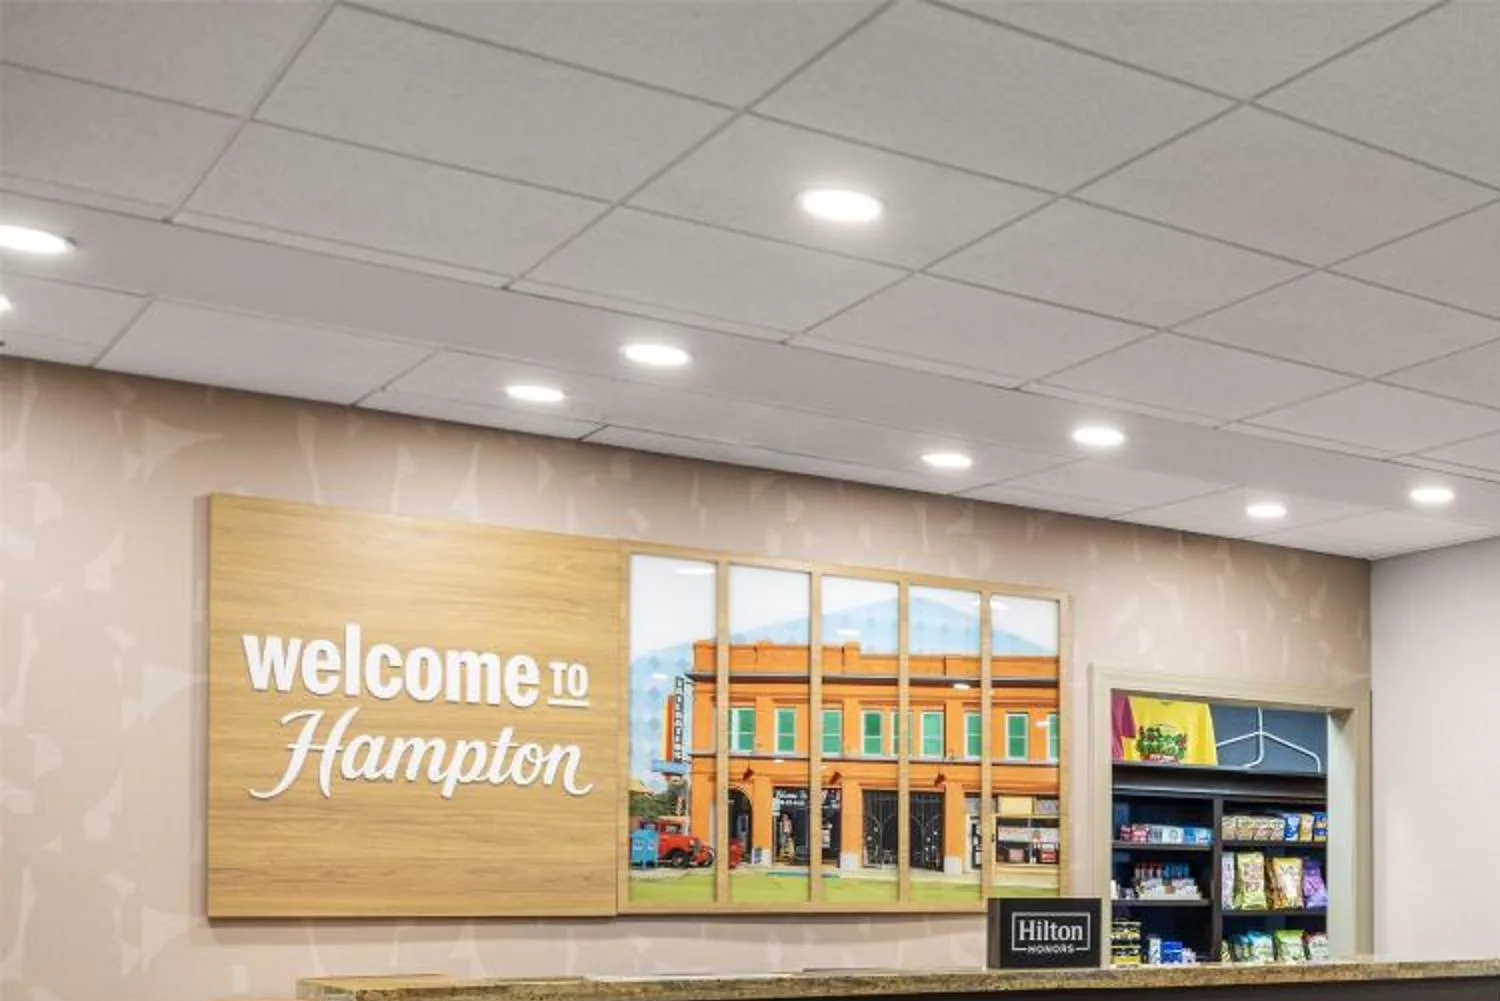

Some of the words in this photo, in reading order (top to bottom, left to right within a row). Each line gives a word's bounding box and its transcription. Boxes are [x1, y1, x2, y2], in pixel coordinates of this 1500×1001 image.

[242, 623, 541, 708] welcome
[548, 660, 590, 698] TO
[249, 706, 593, 799] Hampton
[1019, 919, 1083, 941] Hilton
